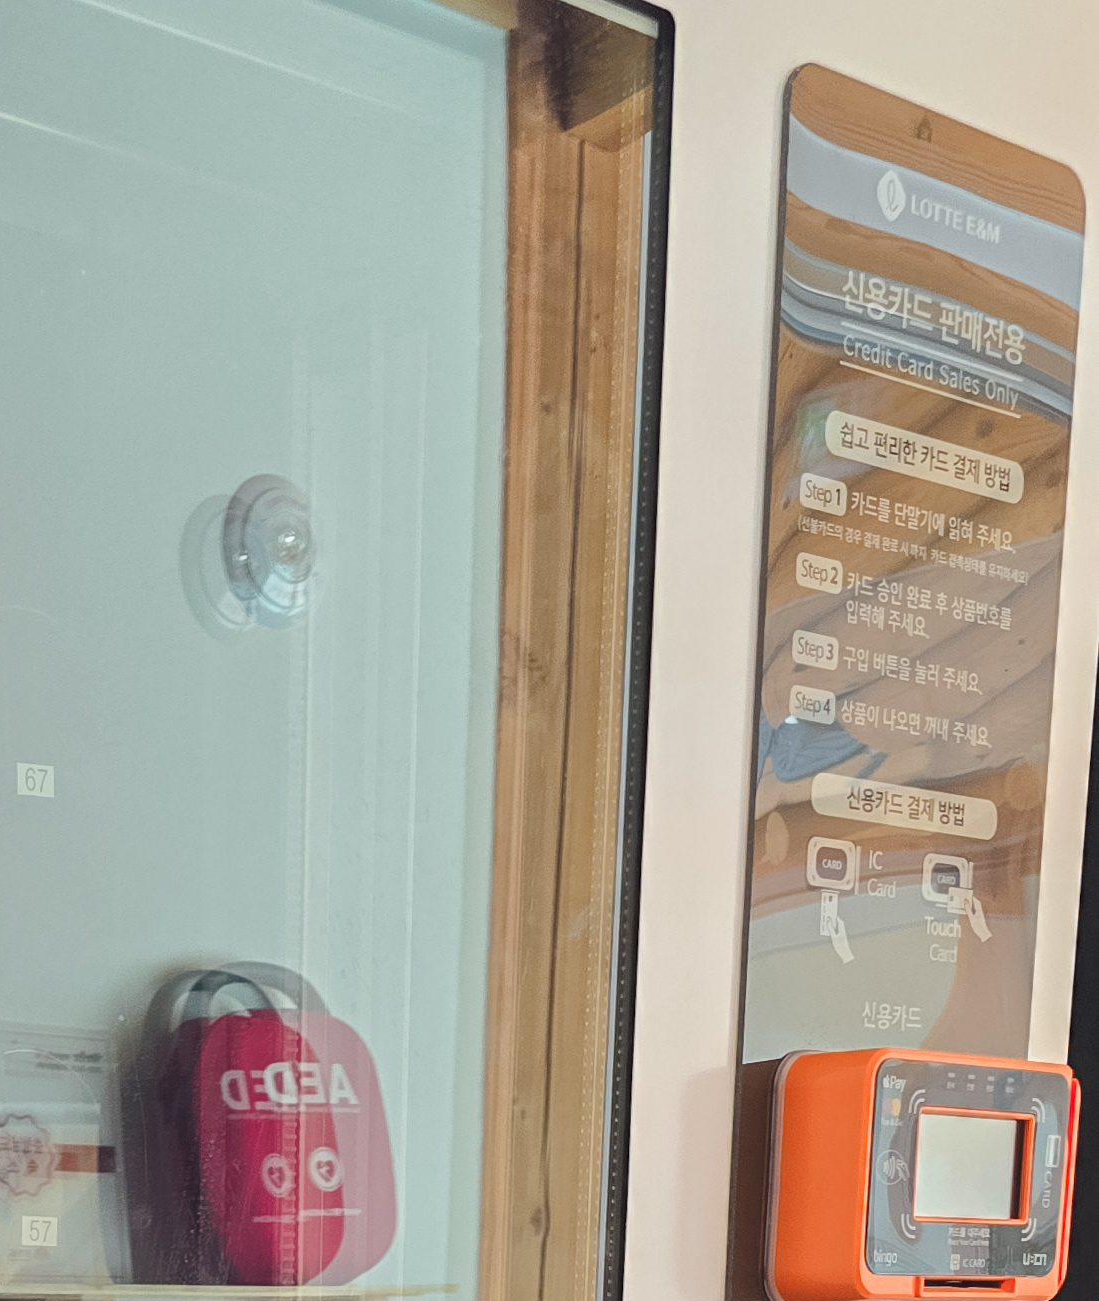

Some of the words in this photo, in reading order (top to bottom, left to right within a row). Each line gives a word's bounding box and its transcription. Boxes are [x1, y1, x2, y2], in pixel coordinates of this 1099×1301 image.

[911, 194, 963, 230] LOTTE
[966, 215, 1000, 244] E&M
[841, 270, 933, 331] 신용카드
[939, 301, 1026, 365] 판매전용
[842, 333, 892, 369] Credit
[897, 351, 933, 380] Card
[939, 364, 979, 395] Sales
[985, 377, 1019, 410] Only
[839, 422, 870, 450] 쉽고
[873, 432, 917, 466] 편리한
[920, 445, 949, 472] 카드
[952, 454, 981, 484] 결제
[983, 463, 1011, 492] 방법
[805, 479, 832, 507] Step
[835, 488, 841, 506] 1
[851, 491, 891, 523] 카드를
[894, 502, 945, 536] 단말기에
[801, 559, 828, 585] Step
[829, 566, 838, 585] 2
[846, 572, 874, 597] 카드
[877, 579, 903, 606] 승인
[906, 586, 932, 610] 완료
[935, 592, 948, 616] 후
[951, 596, 1013, 631] 상품번호를
[846, 600, 885, 631] 입력해
[797, 636, 824, 662] Step
[826, 643, 834, 661] 3
[843, 646, 869, 673] 구입
[873, 652, 912, 681] 버튼을
[914, 660, 940, 687] 눌러
[795, 691, 821, 714] Step
[823, 698, 831, 715] 4
[841, 700, 879, 728] 상품이
[883, 708, 920, 736] 나오면
[923, 716, 949, 742] 꺼내
[24, 767, 49, 793] 67
[846, 786, 904, 816] 신용카드
[907, 795, 935, 822] 결제
[938, 801, 965, 827] 방법
[821, 859, 842, 871] CARD
[868, 850, 883, 870] IC
[867, 878, 896, 899] Card
[936, 874, 956, 886] CARD
[924, 915, 962, 938] Touch
[929, 944, 957, 963] Card
[862, 1001, 922, 1031] 신용카드
[1041, 1170, 1052, 1209] CARD
[29, 1220, 52, 1242] 57
[873, 1249, 898, 1265] bingo
